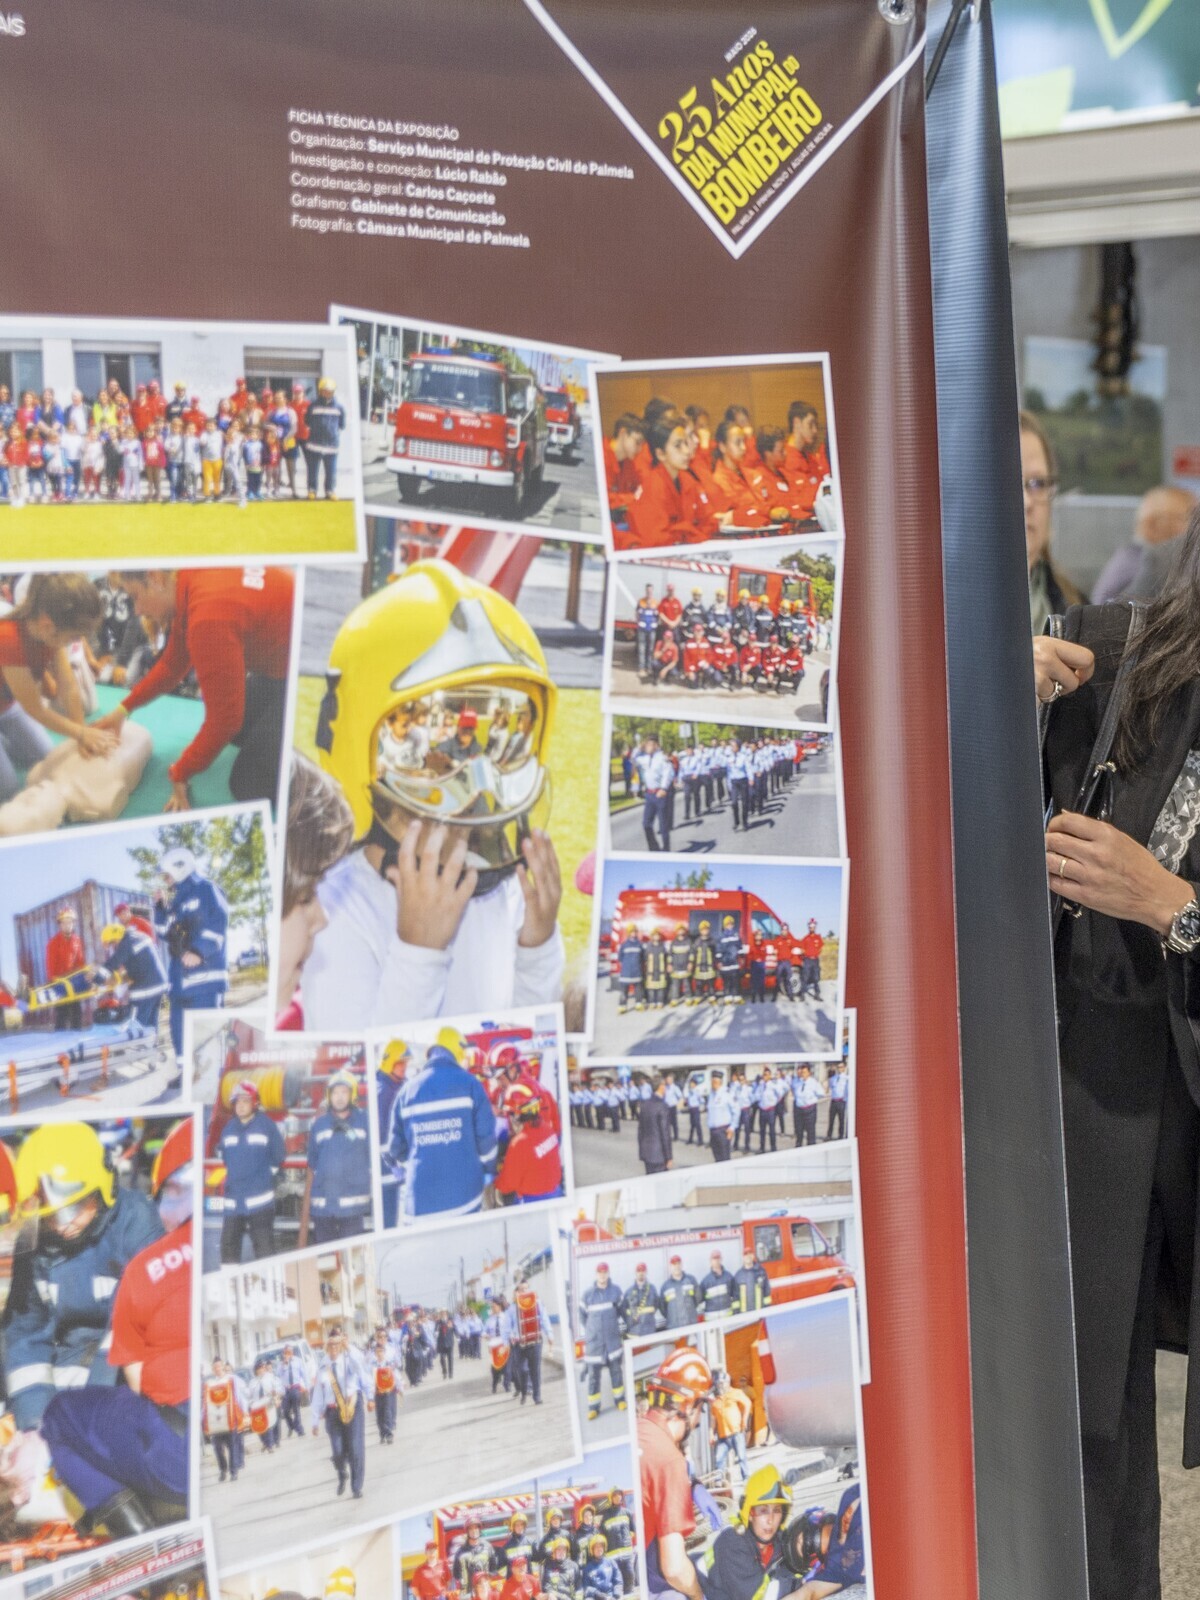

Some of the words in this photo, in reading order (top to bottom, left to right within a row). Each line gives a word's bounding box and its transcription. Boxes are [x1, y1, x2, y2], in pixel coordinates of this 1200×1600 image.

[658, 86, 712, 164] 25
[711, 40, 775, 119] Anos
[288, 110, 324, 125] FICHA
[325, 113, 376, 131] TÉCNICA
[377, 120, 393, 133] DA
[395, 122, 460, 141] EXPOSIÇÃO
[680, 145, 722, 190] DIA
[707, 64, 798, 160] MUNICIPAL
[782, 55, 800, 75] DO
[290, 130, 366, 150] Organização:
[368, 137, 415, 158] Serviço
[416, 143, 474, 164] Municipal
[475, 150, 490, 164] de
[492, 151, 545, 171] Proteção
[546, 156, 572, 173] Civil
[573, 160, 588, 175] de
[589, 161, 634, 179] Palmela
[291, 152, 365, 171] Investigação
[366, 161, 375, 171] e
[376, 162, 434, 180] conceção:
[435, 165, 468, 181] Lúcio
[469, 169, 507, 186] Rabão
[701, 87, 823, 225] BOMBEIRO
[291, 172, 371, 192] Coordenação
[373, 183, 404, 197] geral:
[405, 183, 444, 200] Carlos
[291, 194, 350, 211] Grafismo:
[351, 197, 407, 218] Gabinete
[409, 205, 424, 218] de
[425, 207, 506, 227] Comunicação
[291, 214, 355, 233] Fotografia:
[357, 220, 405, 237] Câmara
[407, 223, 465, 243] Municipal
[466, 229, 481, 244] de
[483, 230, 531, 248] Palmela
[412, 1117, 463, 1134] BOMBEIROS
[415, 1130, 462, 1146] FORMAÇÃO
[147, 1542, 205, 1572] PALMEL
